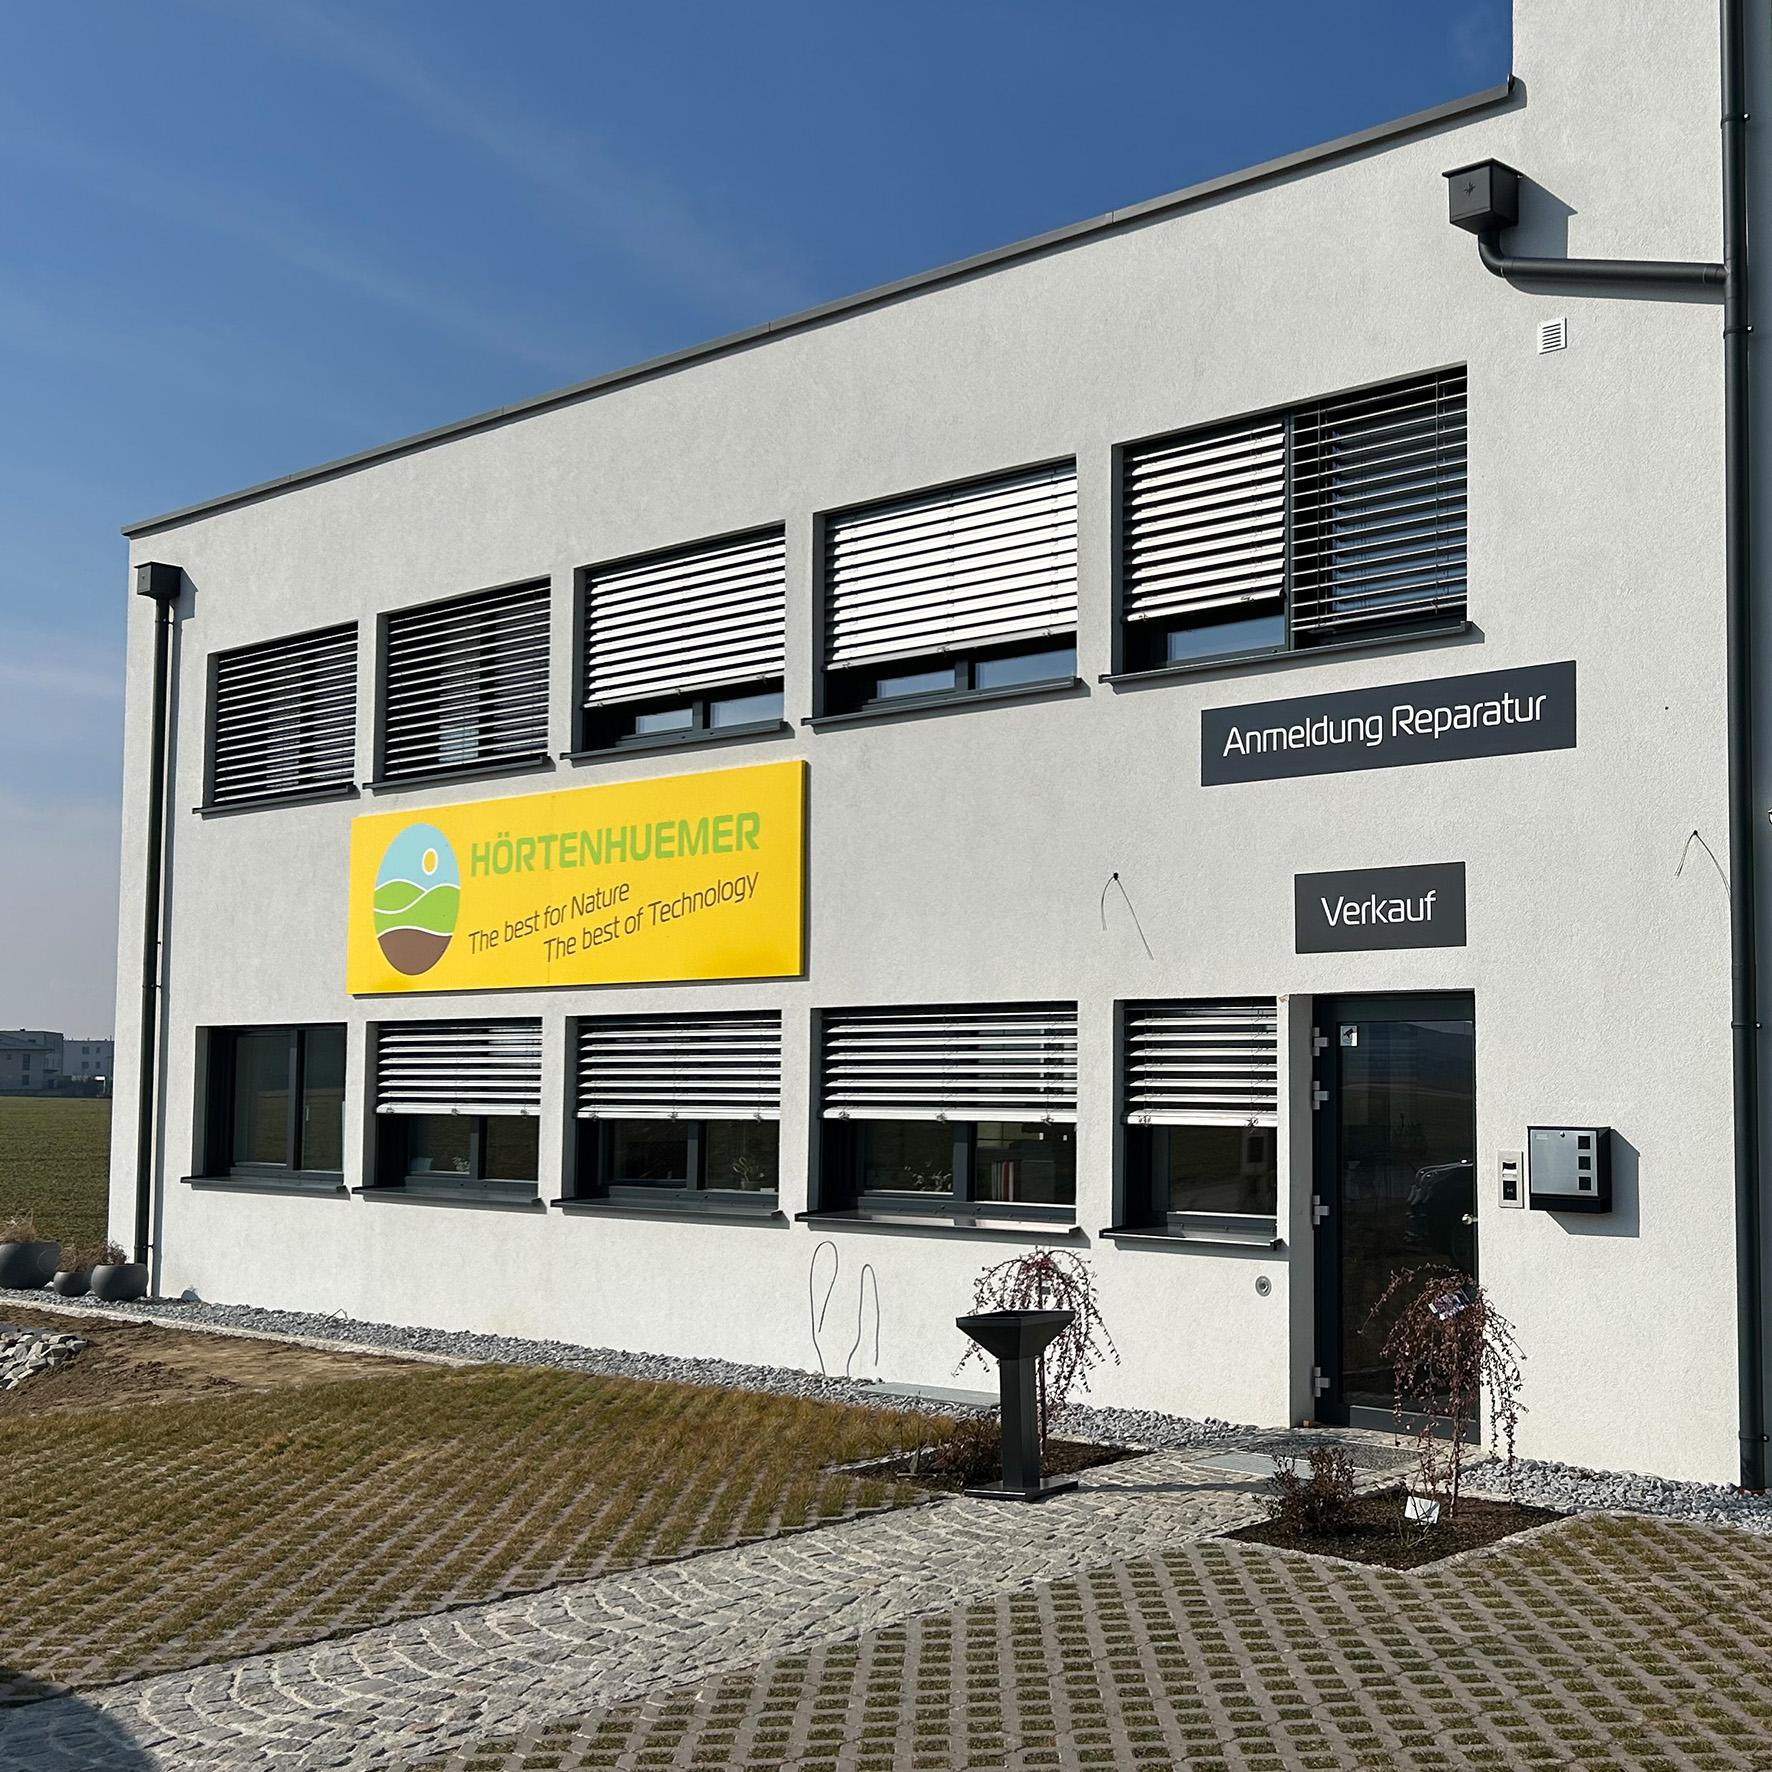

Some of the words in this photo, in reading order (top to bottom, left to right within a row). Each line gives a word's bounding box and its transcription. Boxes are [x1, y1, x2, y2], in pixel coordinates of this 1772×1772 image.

[1222, 714, 1383, 757] Anmeldung
[1392, 692, 1547, 739] Reparatur
[470, 811, 761, 877] HÖRTENHUEMER
[468, 926, 499, 955] The
[504, 910, 541, 944] best
[543, 904, 568, 929] for
[571, 881, 630, 920] Nature
[543, 934, 577, 963] The
[582, 916, 621, 950] best
[624, 906, 644, 935] of
[647, 871, 760, 927] Technology
[1320, 889, 1437, 927] Verkauf
